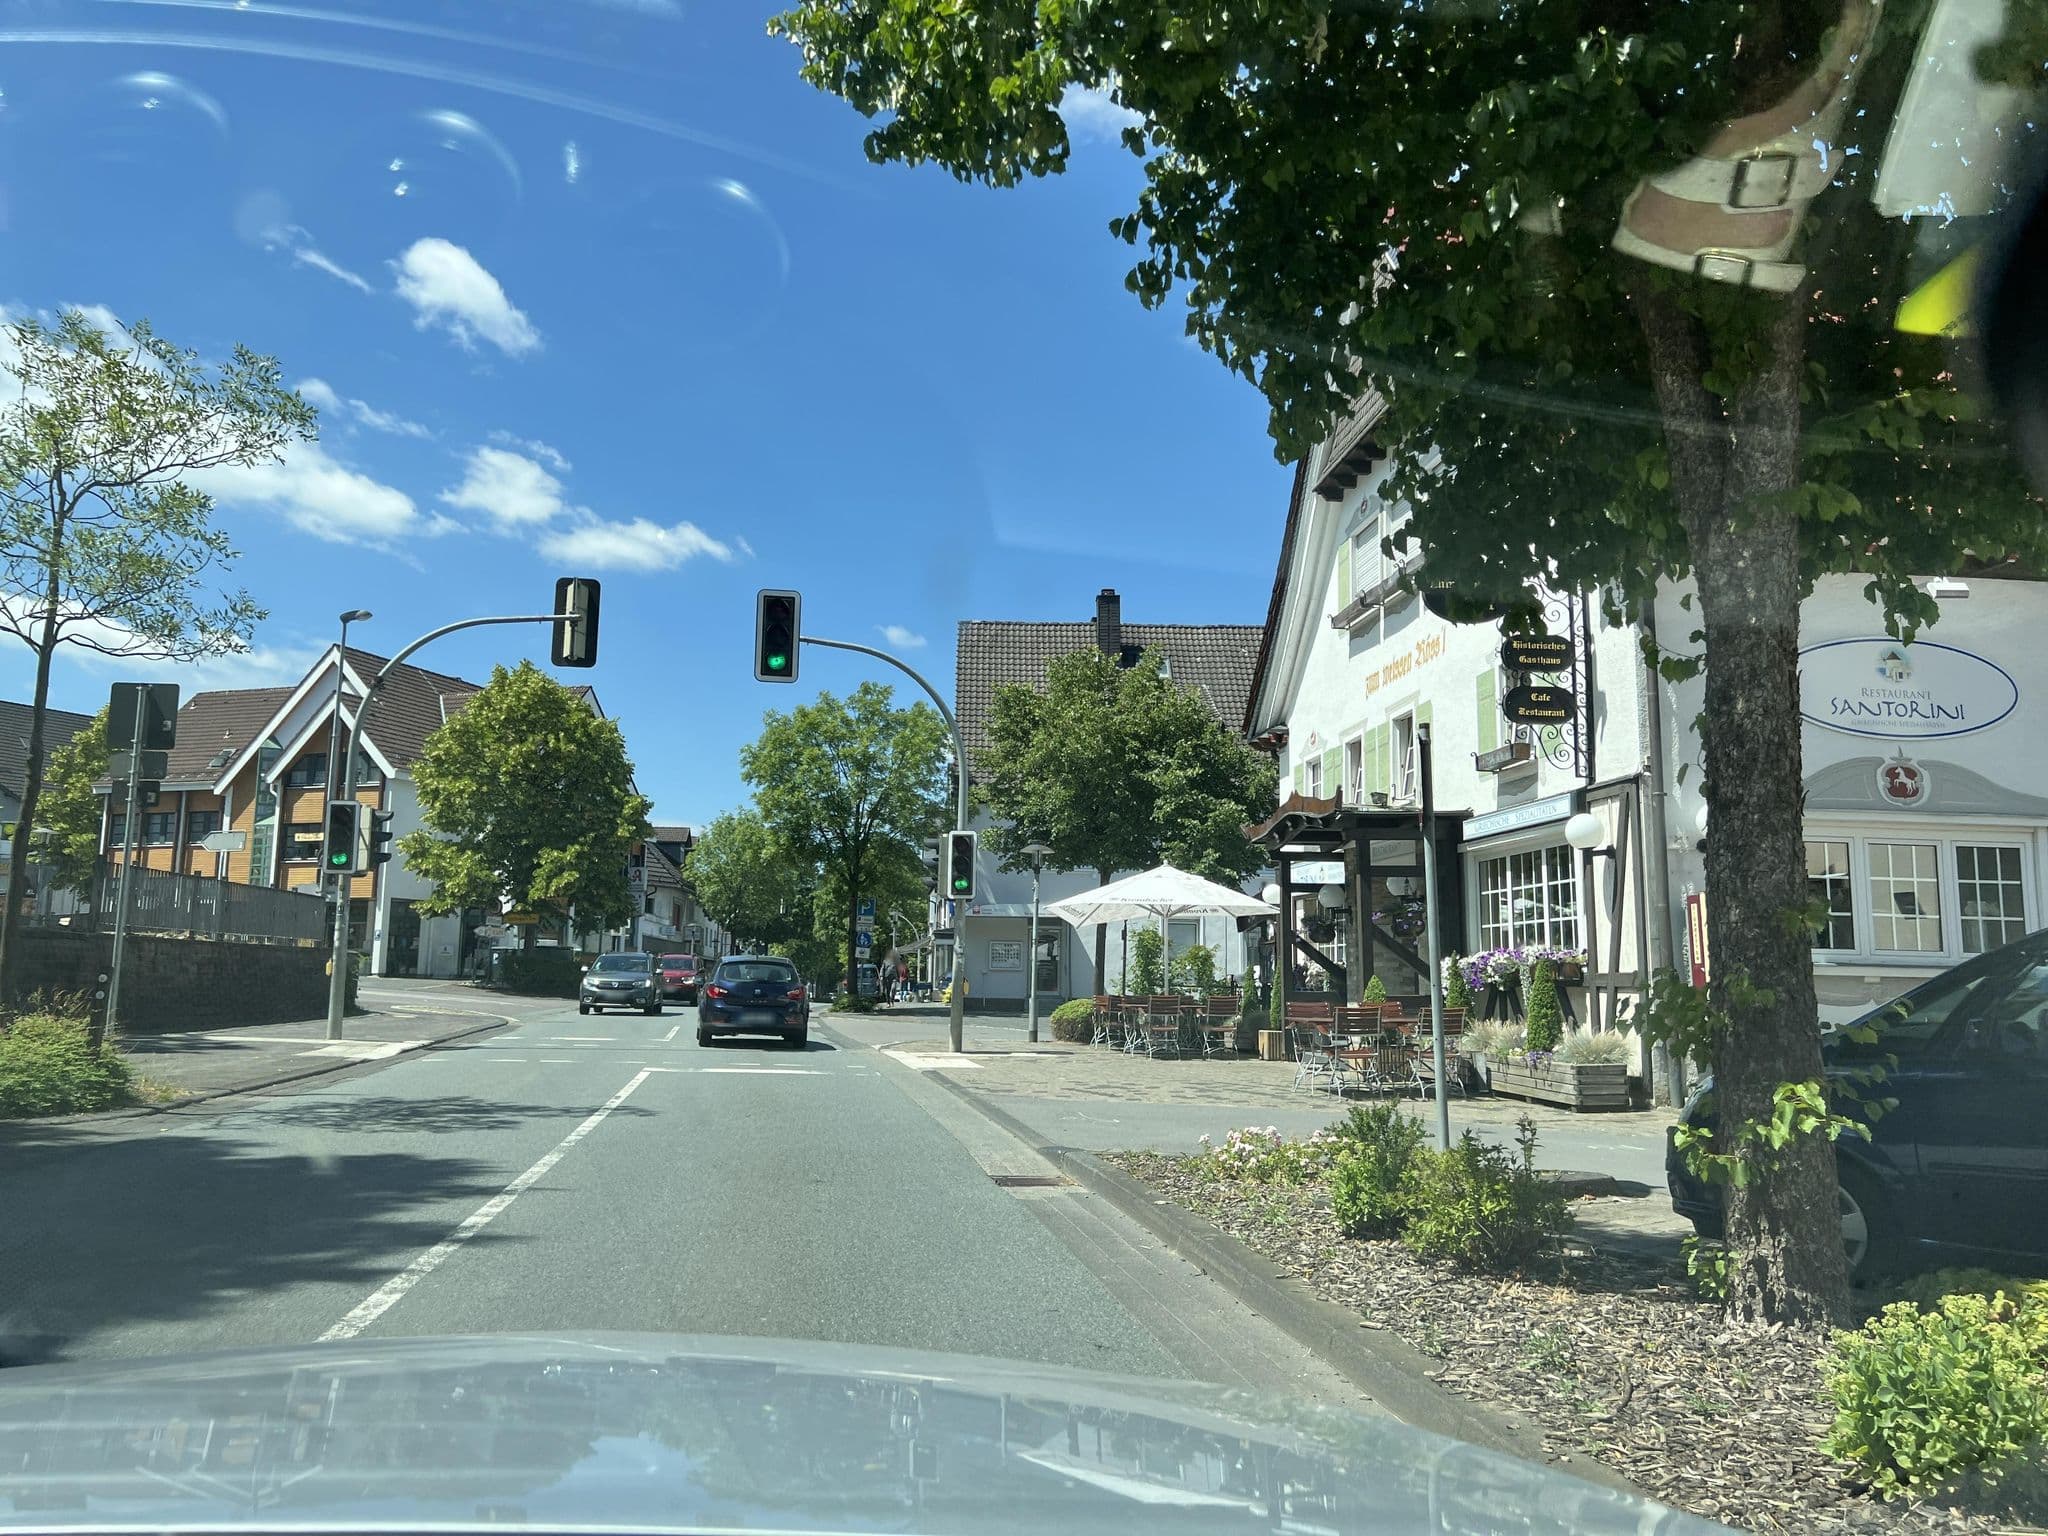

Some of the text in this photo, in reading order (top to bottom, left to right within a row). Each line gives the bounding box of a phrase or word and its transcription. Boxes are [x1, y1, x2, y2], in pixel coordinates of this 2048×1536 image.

[1512, 640, 1566, 651] Historisches
[1519, 655, 1561, 665] Gasthaus
[1530, 692, 1551, 702] Cafe
[1518, 707, 1565, 717] Restaurant
[1831, 697, 1965, 720] SANTORINI
